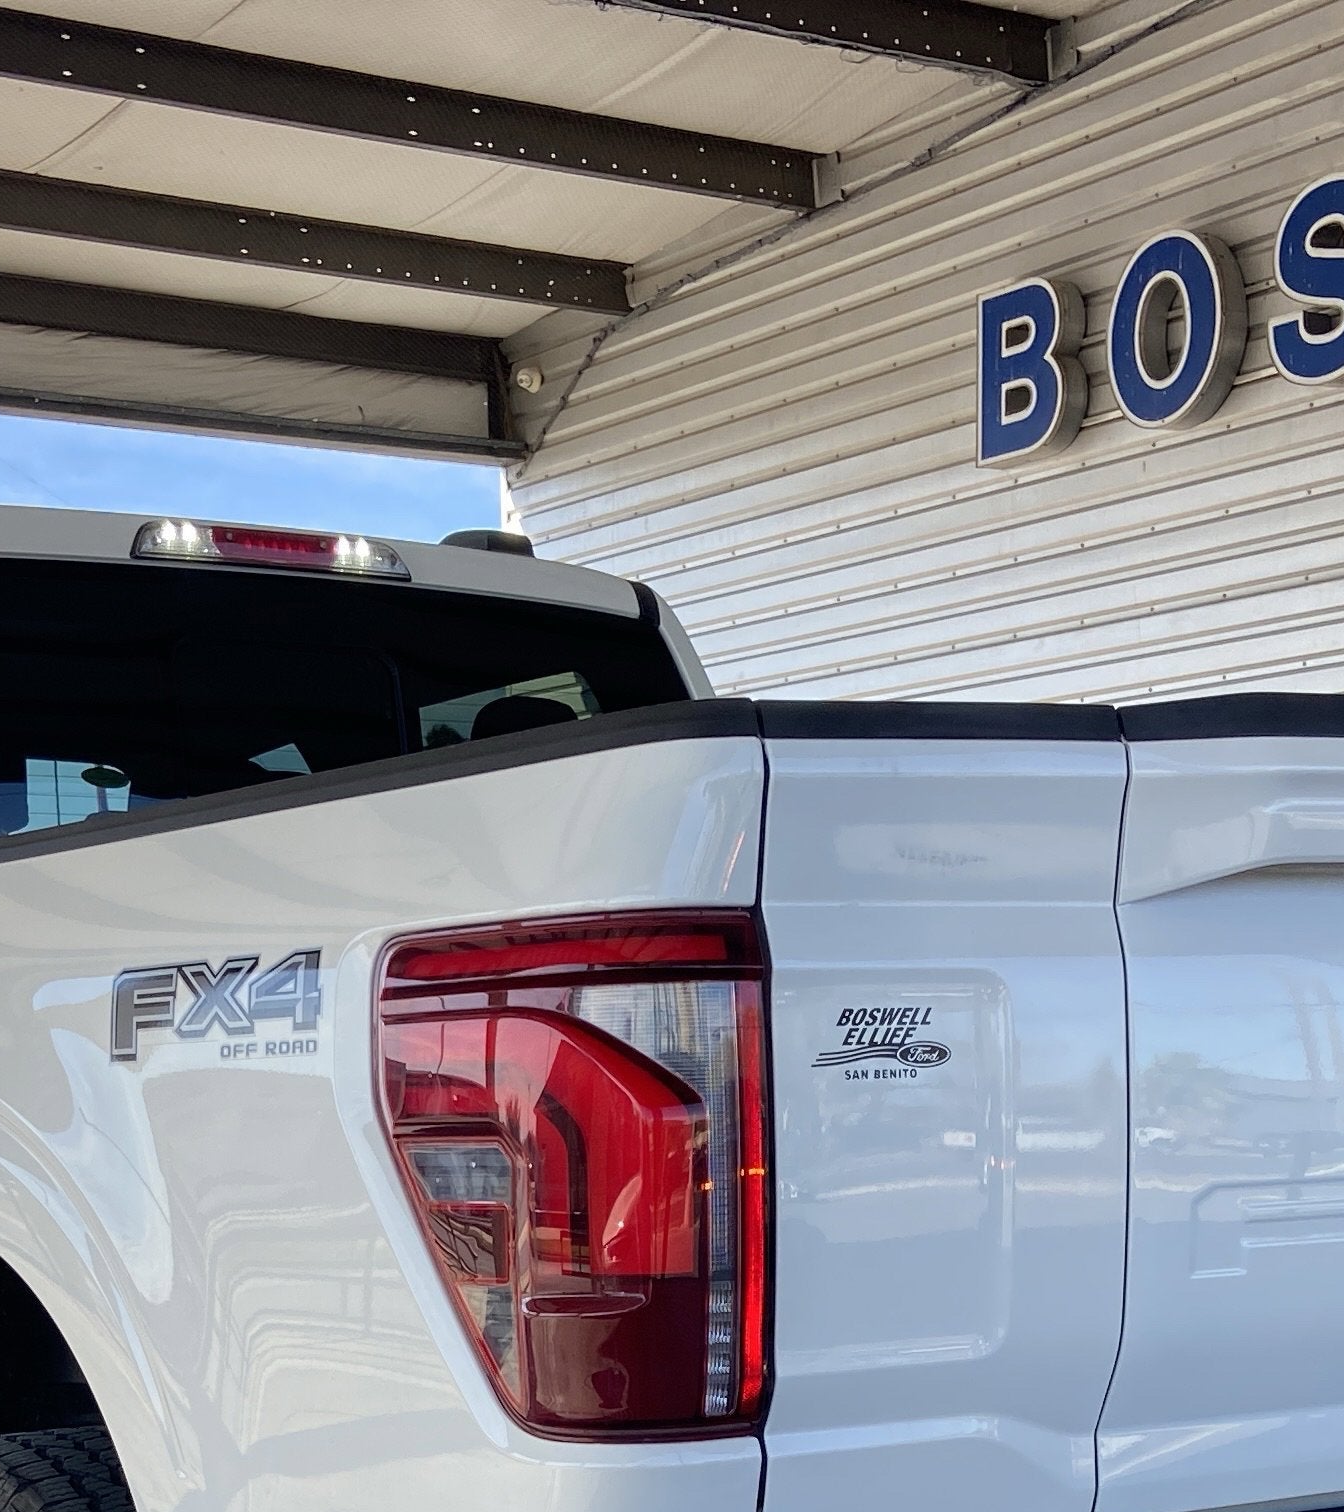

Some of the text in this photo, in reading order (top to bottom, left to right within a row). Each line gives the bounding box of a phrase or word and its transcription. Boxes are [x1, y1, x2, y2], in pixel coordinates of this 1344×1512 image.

[110, 946, 324, 1063] FX4
[836, 1007, 932, 1027] BOSWELL
[842, 1027, 917, 1046] ELLIFF
[220, 1039, 318, 1058] OFF ROAD
[908, 1046, 940, 1062] Ford
[844, 1068, 918, 1080] SAN BENITO
